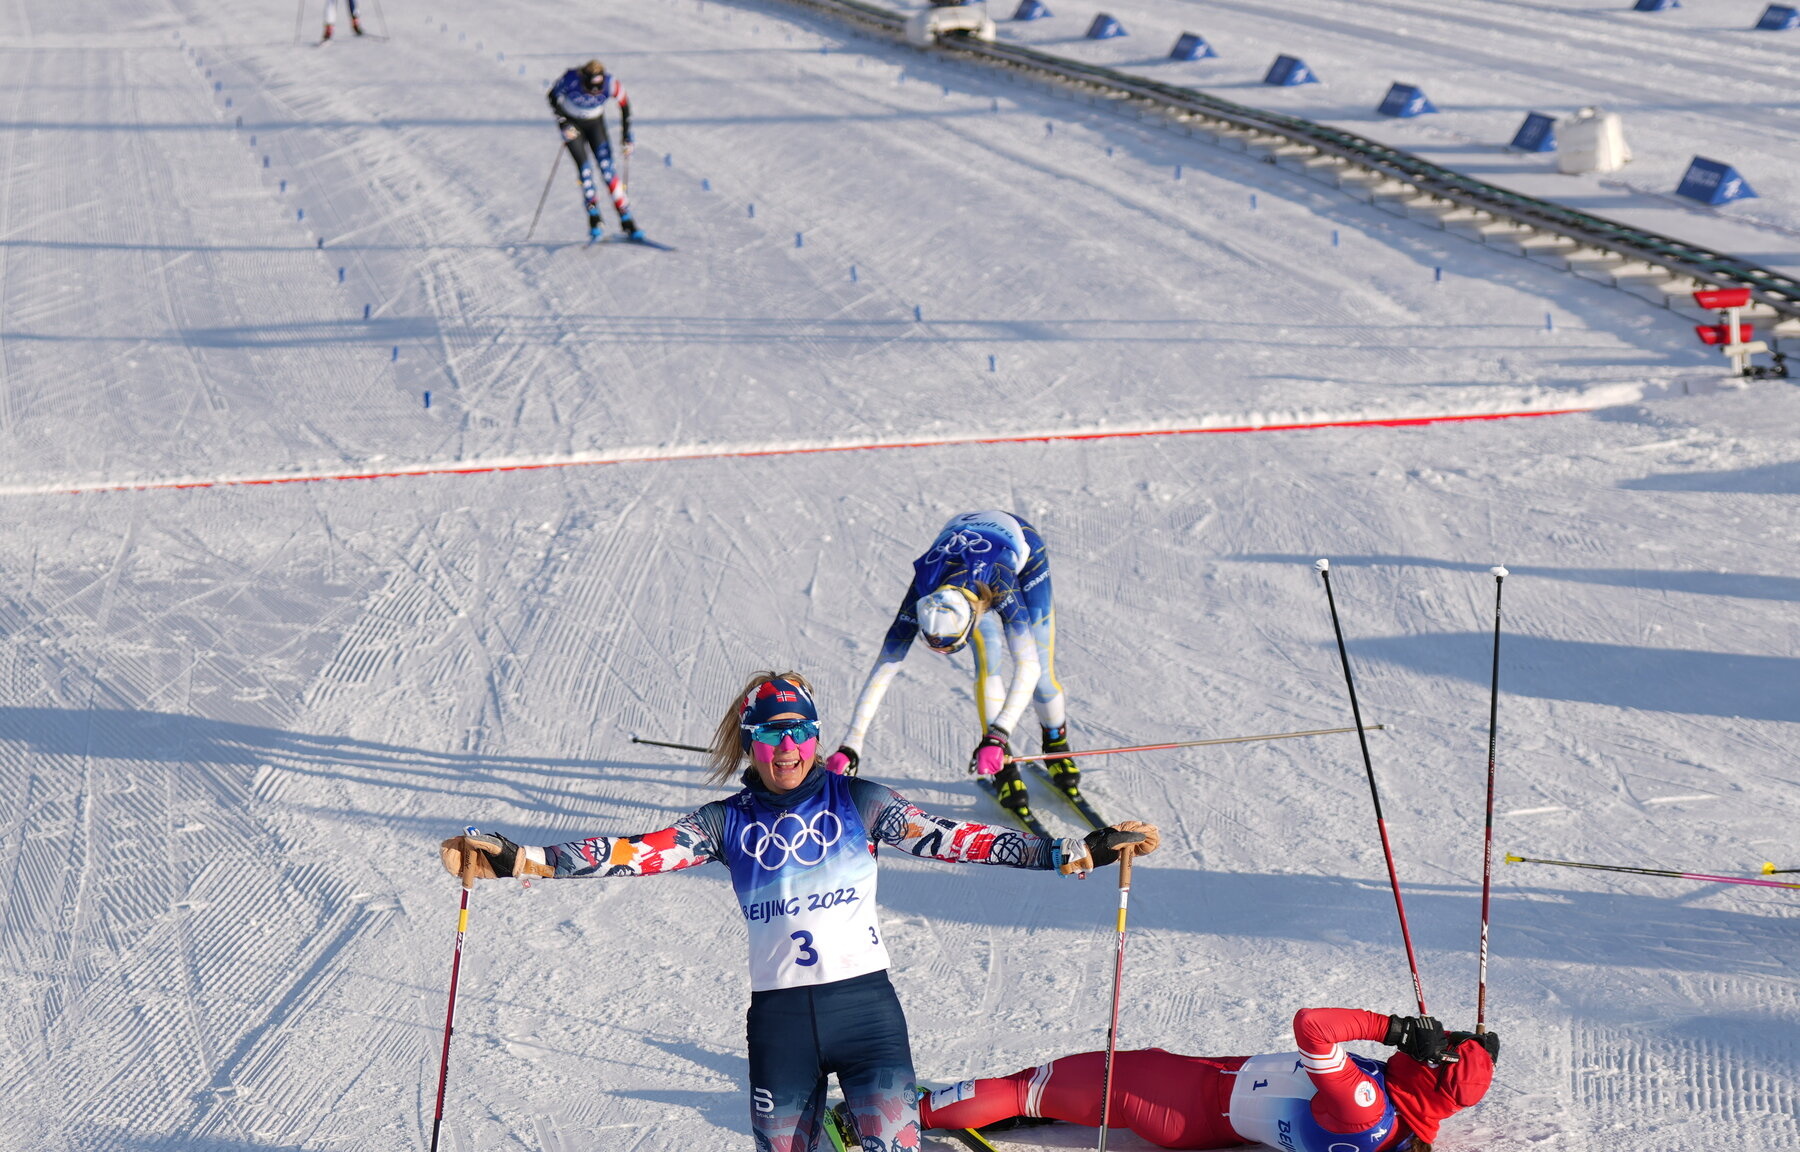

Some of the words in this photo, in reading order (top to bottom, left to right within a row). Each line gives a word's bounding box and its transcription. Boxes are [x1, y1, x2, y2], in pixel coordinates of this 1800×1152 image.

[743, 897, 801, 924] BEIJING
[807, 887, 859, 912] 2022
[868, 926, 879, 945] 3
[790, 930, 819, 967] 3
[940, 1086, 954, 1095] 1
[1253, 1079, 1269, 1091] 1
